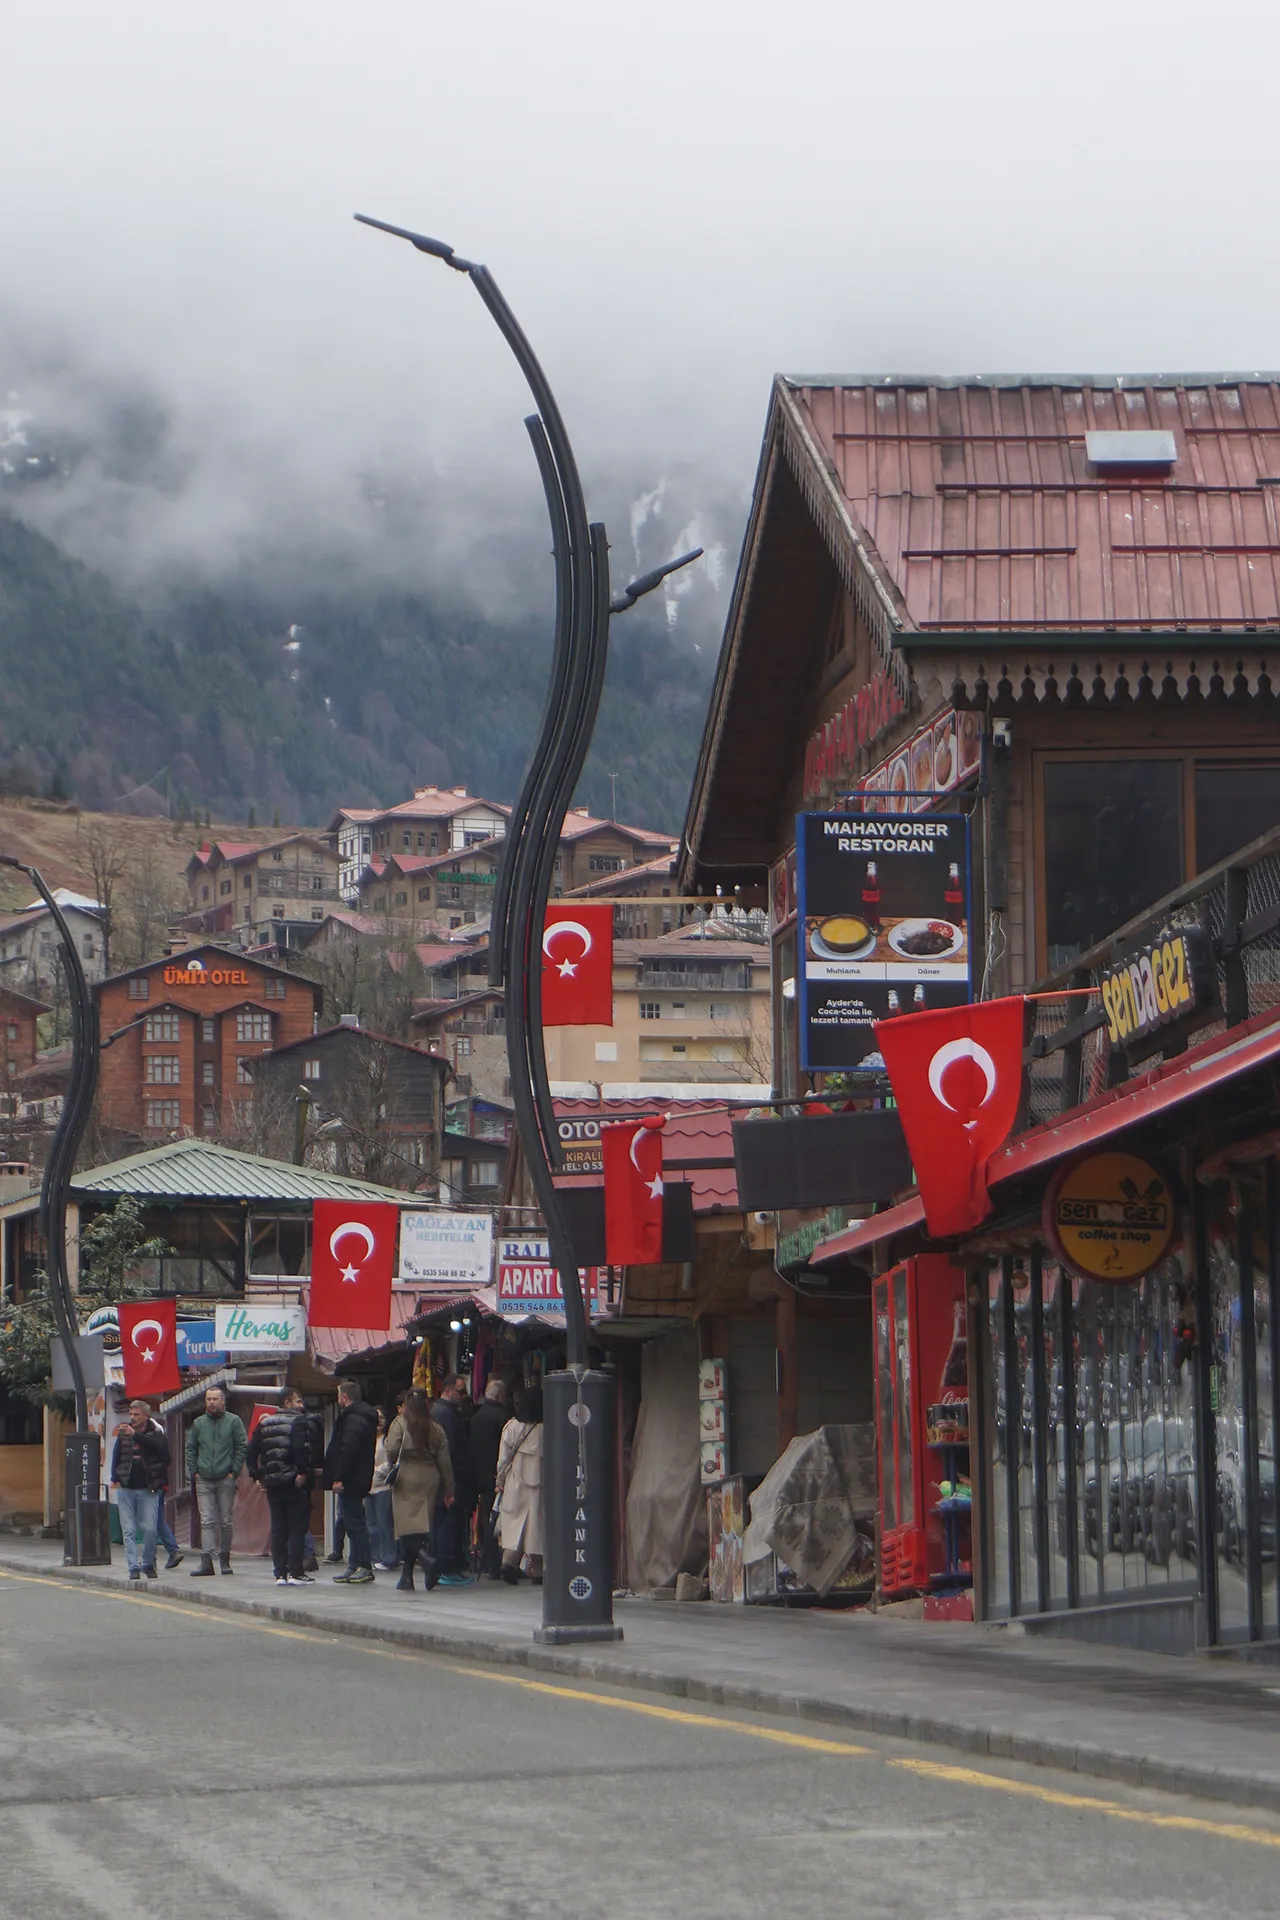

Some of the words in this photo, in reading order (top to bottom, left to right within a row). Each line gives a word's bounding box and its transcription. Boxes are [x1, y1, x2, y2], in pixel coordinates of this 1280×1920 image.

[823, 821, 949, 836] MAHAYVORER
[838, 838, 934, 852] RESTORAN
[211, 969, 249, 985] OTEL
[826, 967, 861, 975] Muhlama
[826, 999, 864, 1007] Ayder'de
[810, 1016, 838, 1024] lezzeti
[1078, 1229, 1117, 1240] coffee
[1119, 1231, 1151, 1243] shop
[422, 1268, 437, 1277] 0535
[501, 1268, 553, 1295] APART
[502, 1302, 525, 1311] 0535
[527, 1302, 544, 1311] 546
[547, 1302, 558, 1311] 86
[224, 1309, 295, 1342] Hevas
